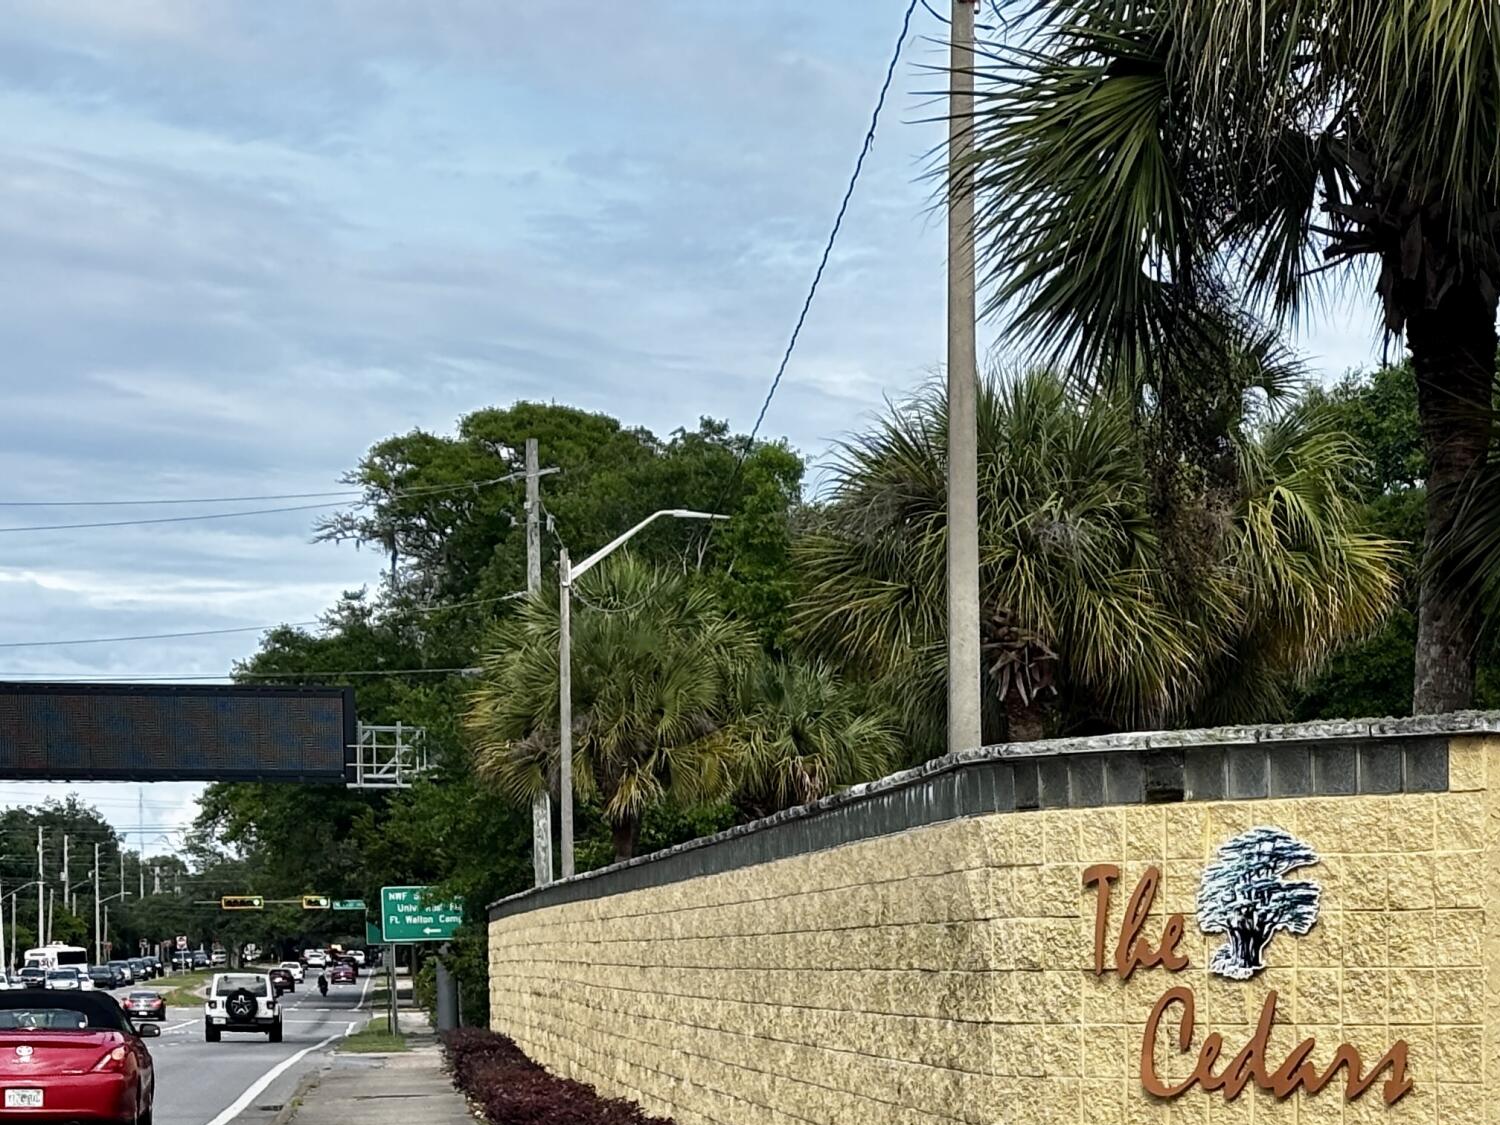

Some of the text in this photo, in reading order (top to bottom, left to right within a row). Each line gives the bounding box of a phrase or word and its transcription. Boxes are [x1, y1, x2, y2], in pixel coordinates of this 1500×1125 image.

[388, 892, 407, 900] NWF
[405, 915, 433, 924] Walton
[1083, 864, 1189, 979] The
[1141, 986, 1412, 1106] Cedars
